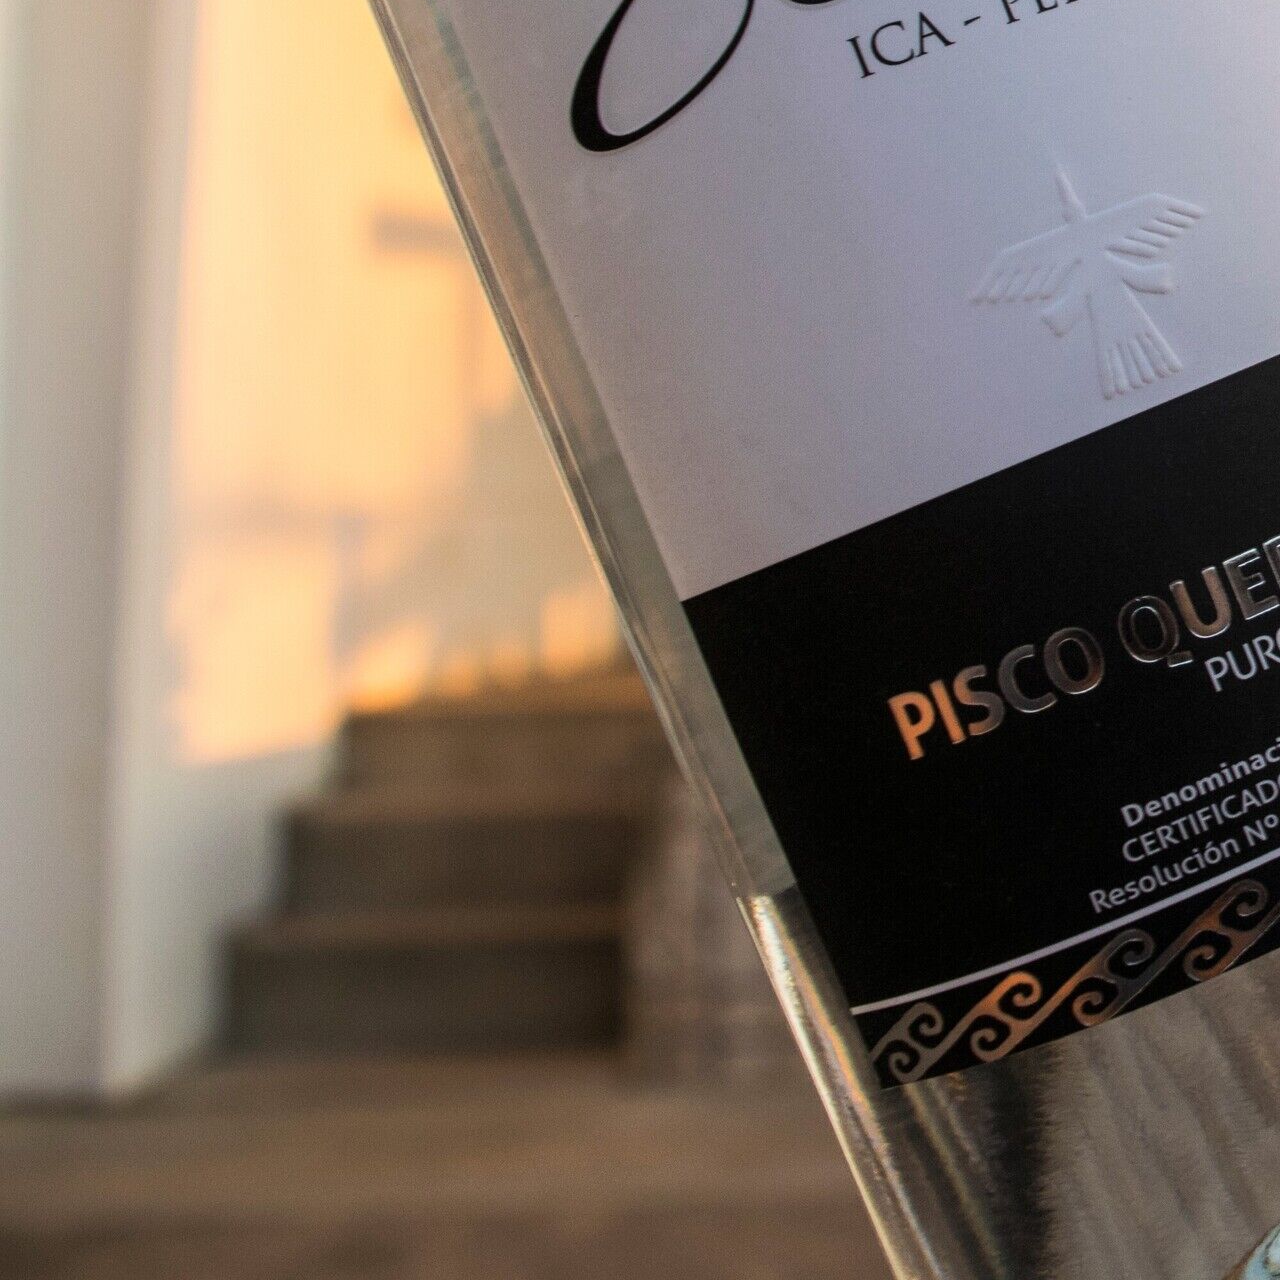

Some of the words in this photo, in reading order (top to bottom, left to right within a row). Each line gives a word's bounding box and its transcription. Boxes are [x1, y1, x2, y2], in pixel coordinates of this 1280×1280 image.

[846, 10, 955, 79] ICA
[887, 625, 1105, 761] PISCO
[1088, 837, 1241, 914] Resolución
